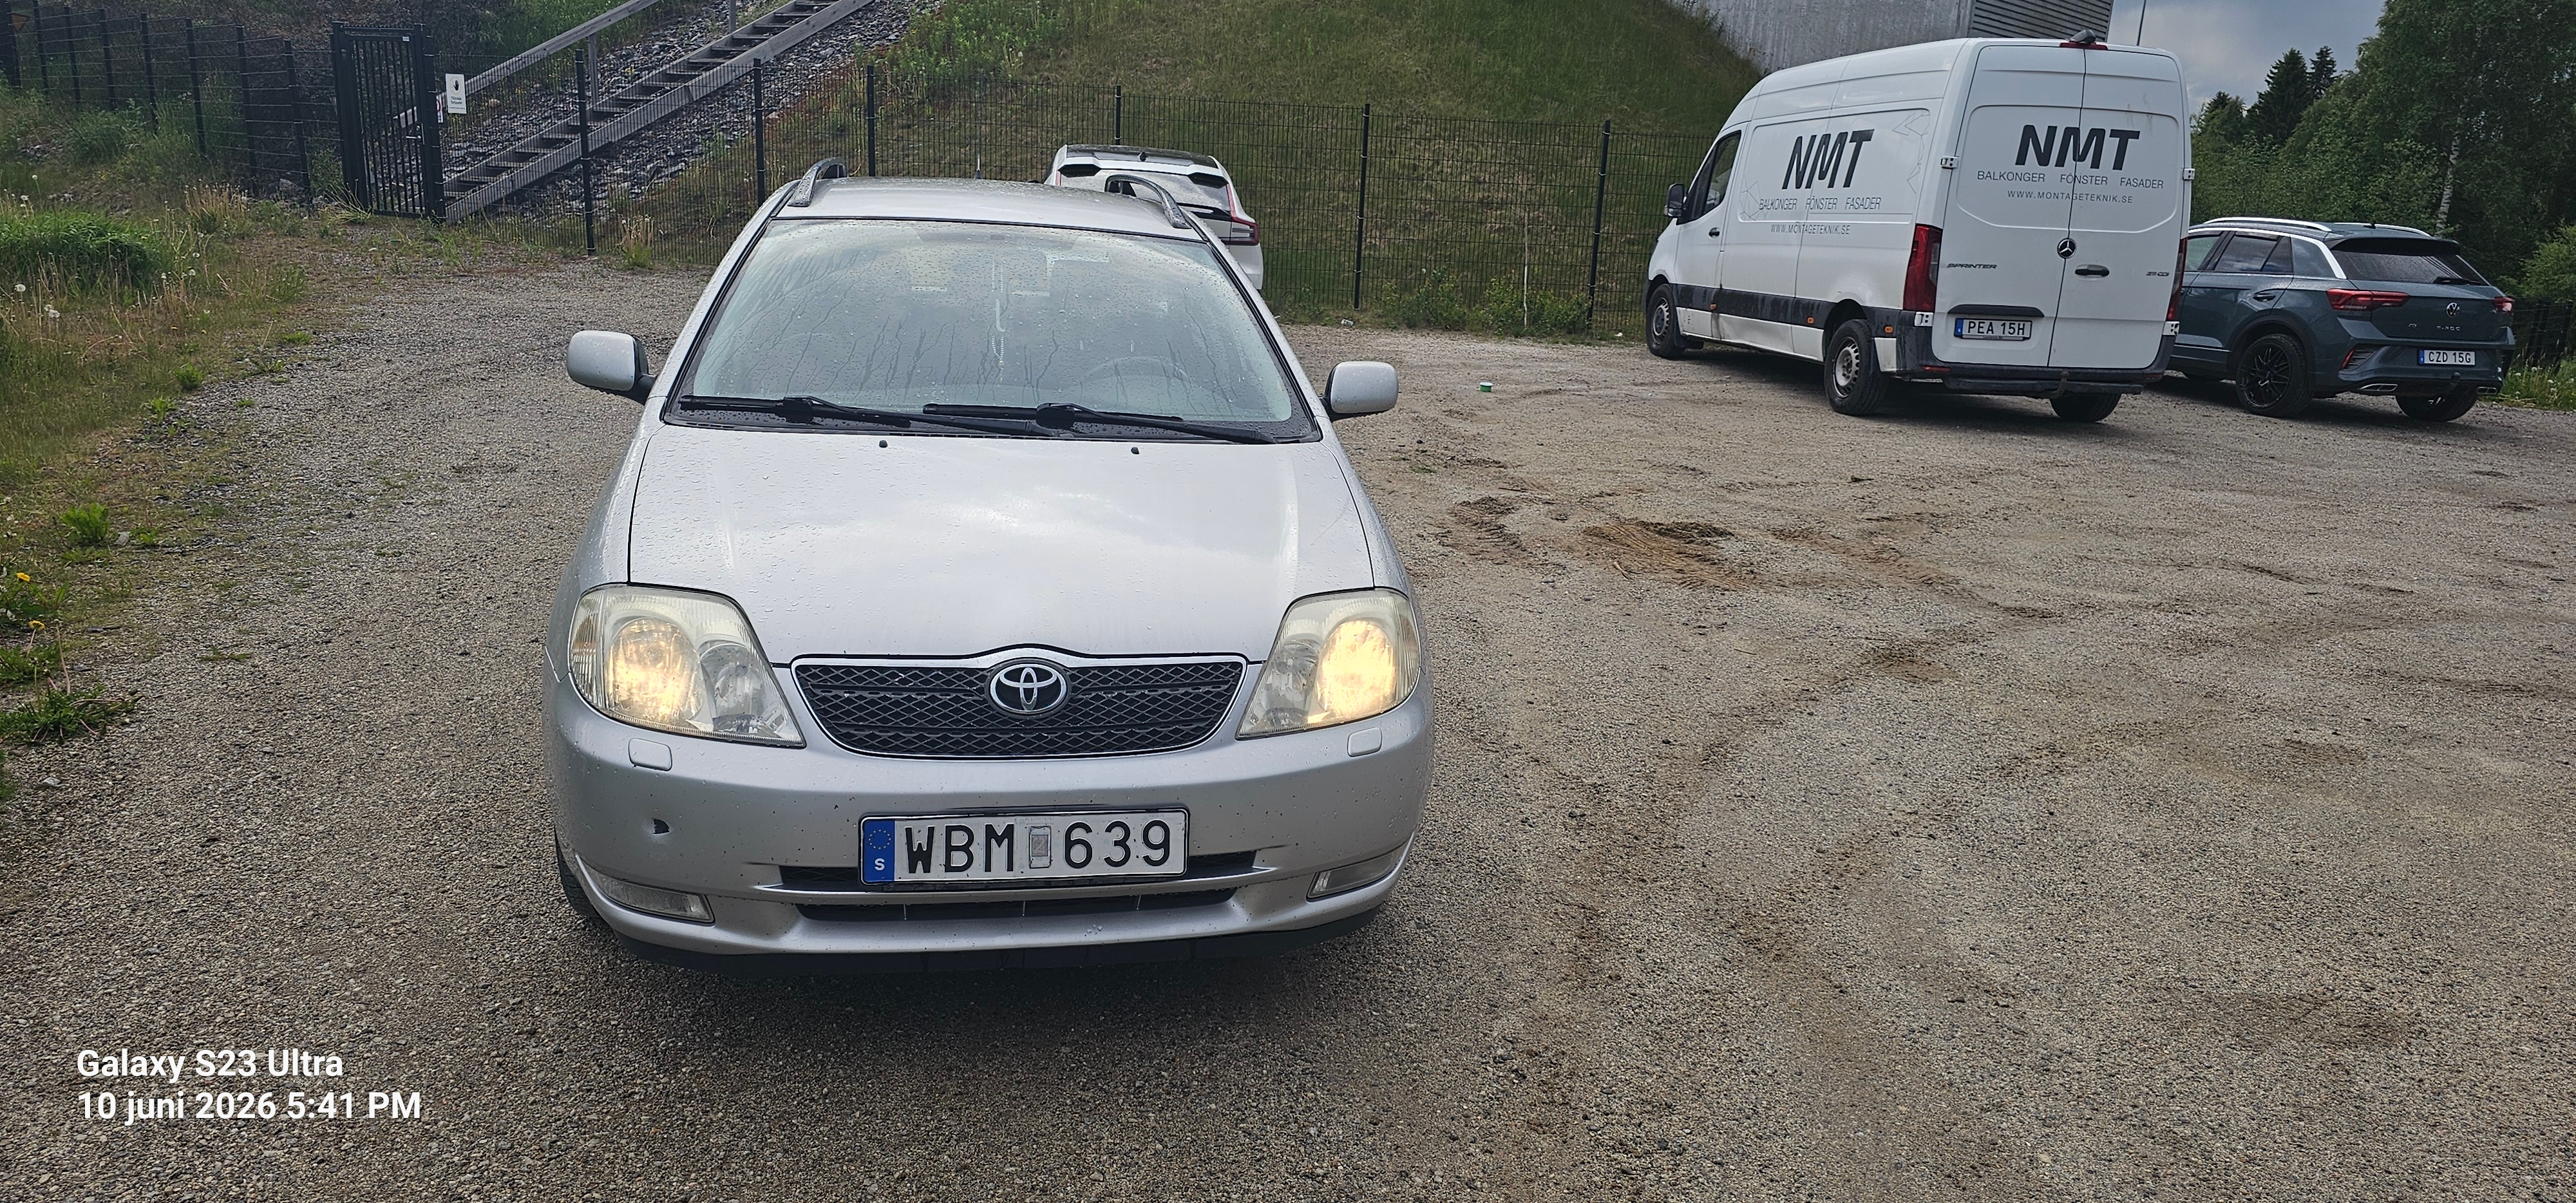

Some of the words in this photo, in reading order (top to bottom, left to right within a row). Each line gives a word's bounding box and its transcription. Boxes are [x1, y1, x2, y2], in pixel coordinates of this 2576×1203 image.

[2014, 124, 2141, 171] NMT
[1781, 129, 1875, 189] NMT
[1976, 171, 2045, 182] BALKONGER
[2060, 173, 2108, 185] FÖNSTER
[2119, 177, 2164, 189] FASADER
[1759, 198, 1797, 210] BALKONGER
[1805, 196, 1838, 210] FÖNSTER
[1844, 197, 1882, 210] FASADER
[2007, 190, 2134, 204] WWW.MONTAGETEKNIK.SE
[1967, 321, 1994, 334] PEA
[2000, 322, 2025, 336] 15H
[2429, 351, 2448, 363] CZD
[2452, 352, 2471, 363] 15G
[905, 823, 1014, 874] WBM
[1065, 820, 1170, 869] 639
[874, 858, 886, 871] S
